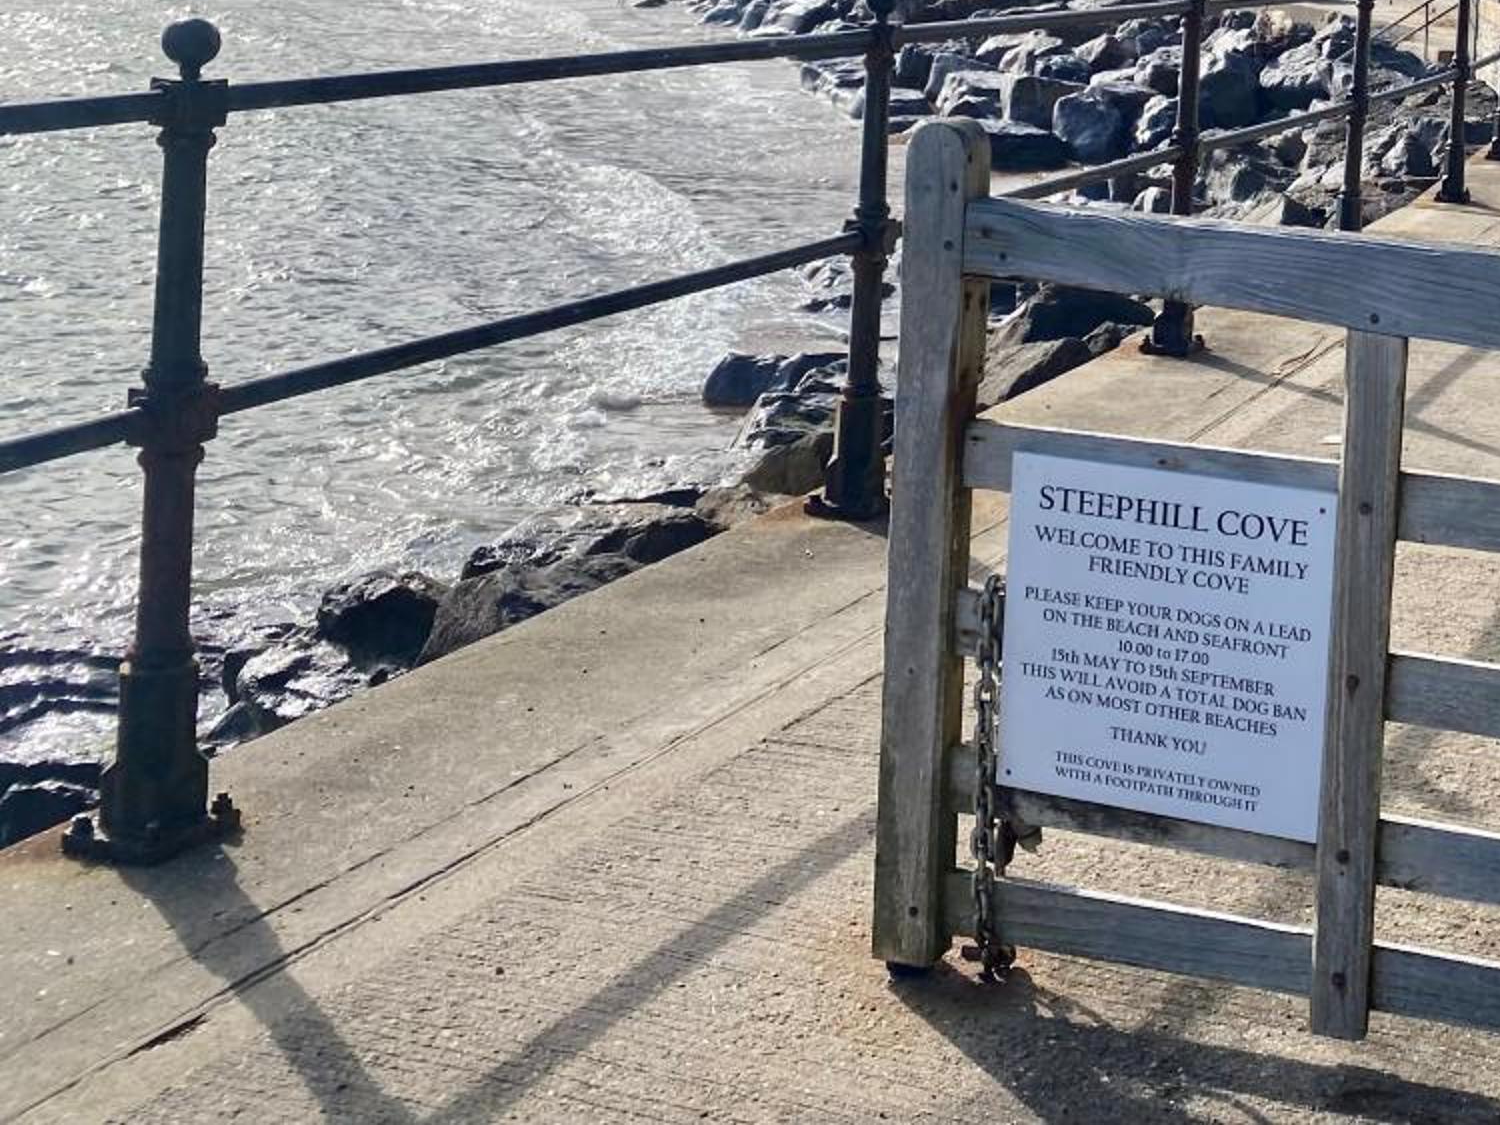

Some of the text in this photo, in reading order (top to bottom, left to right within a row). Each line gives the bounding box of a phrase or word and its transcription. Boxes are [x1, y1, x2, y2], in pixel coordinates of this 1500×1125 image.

[1039, 485, 1309, 546] STEEPHILL COVE
[1035, 525, 1309, 579] WELCOME TO THIS FAMILY
[1088, 556, 1249, 594] FRIENDLY COVE
[1025, 586, 1311, 642] PLEASE KEEP YOUR DOGS ON A LEAD
[1043, 609, 1290, 659] ON THE BEACH AND SEAFRONT
[1052, 647, 1275, 697] 15th MAY TO 15th SEPTEMBER
[1157, 647, 1170, 659] to
[1020, 662, 1307, 721] THIS WILL AVOID A TOTAL DOG BAN
[1045, 685, 1278, 736] AS ON MOST OTHER BEACHES
[1110, 726, 1207, 755] THANK YOU
[1055, 765, 1258, 812] WITH A FOOTPATH THROUGH IT
[1056, 750, 1260, 797] THIS COVE IS PRIVATELY OWNED
